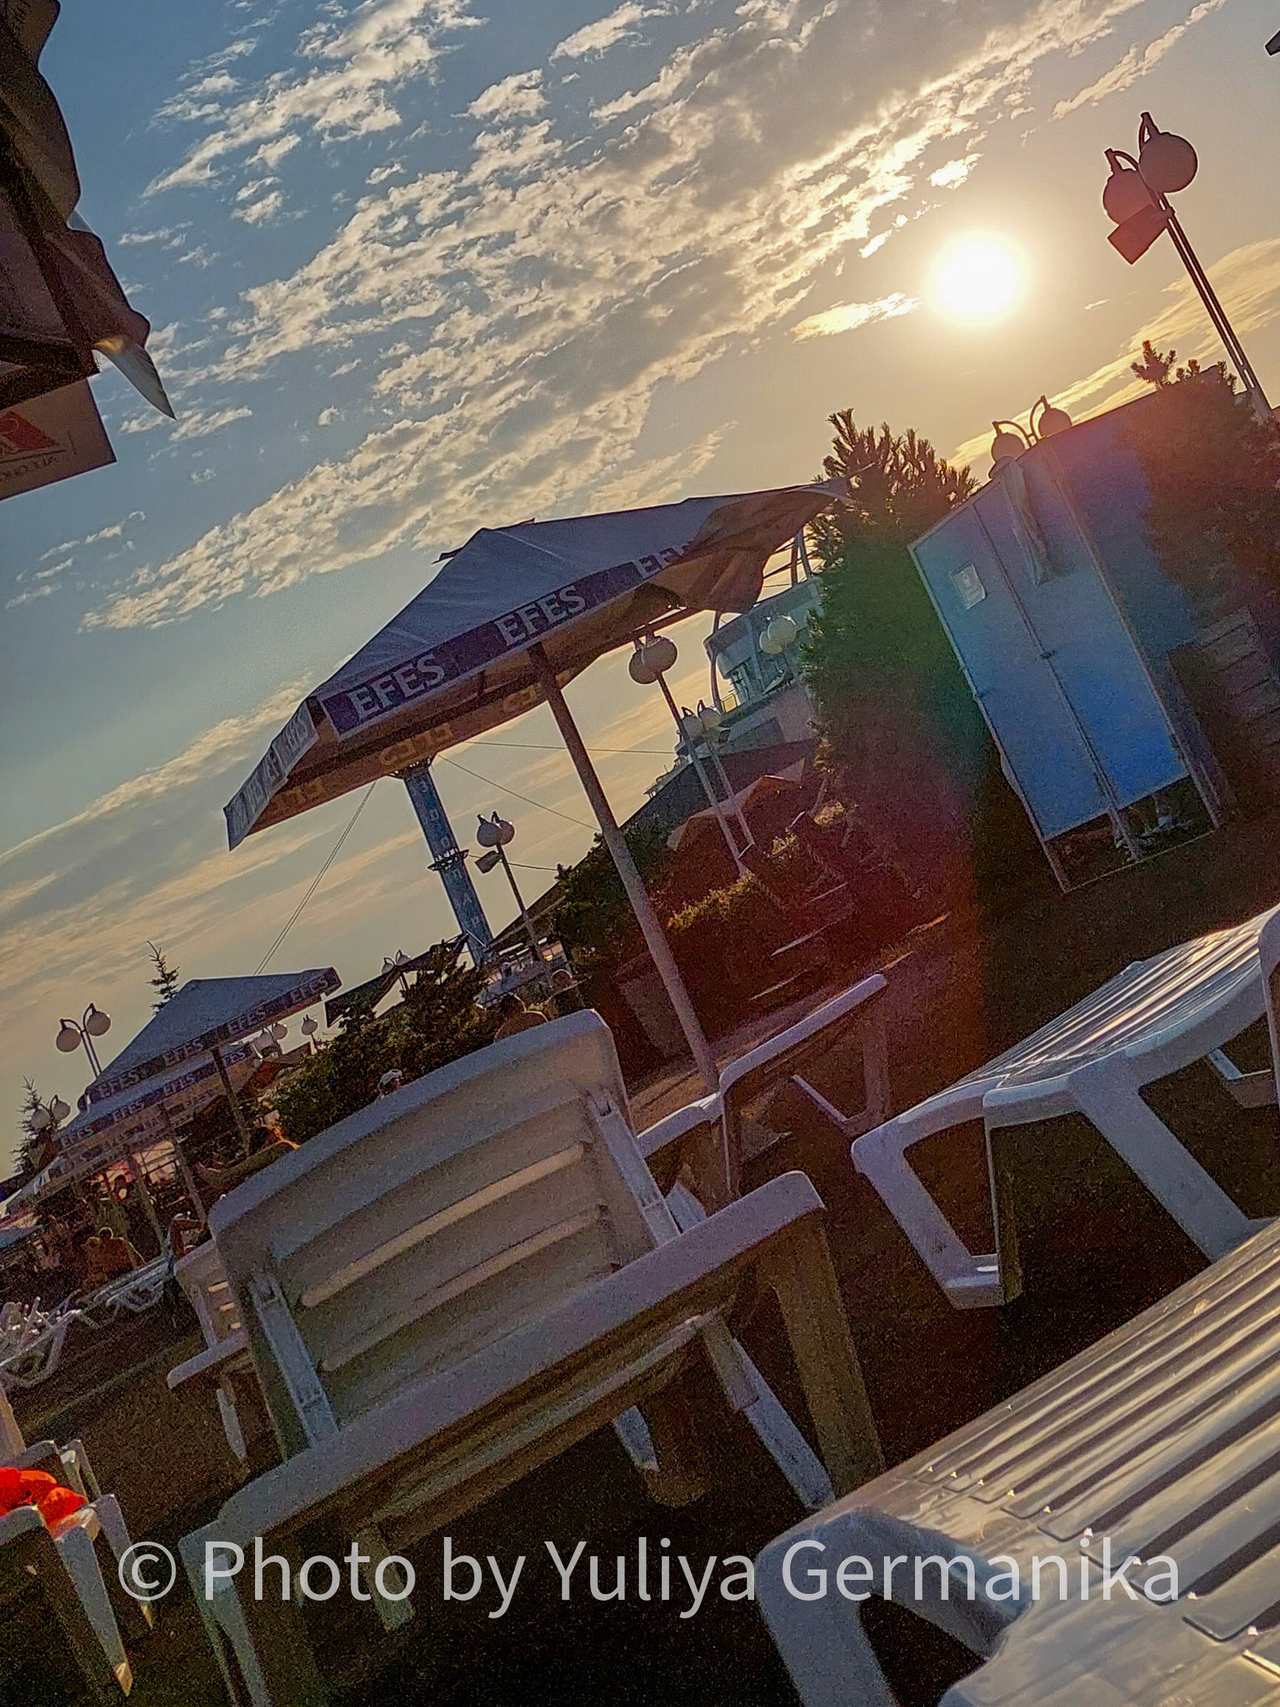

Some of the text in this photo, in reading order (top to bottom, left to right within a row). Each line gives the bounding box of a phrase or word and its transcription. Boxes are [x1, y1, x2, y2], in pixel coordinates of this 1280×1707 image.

[347, 540, 692, 721] EFES EFES EF
[227, 1008, 267, 1034] EFES
